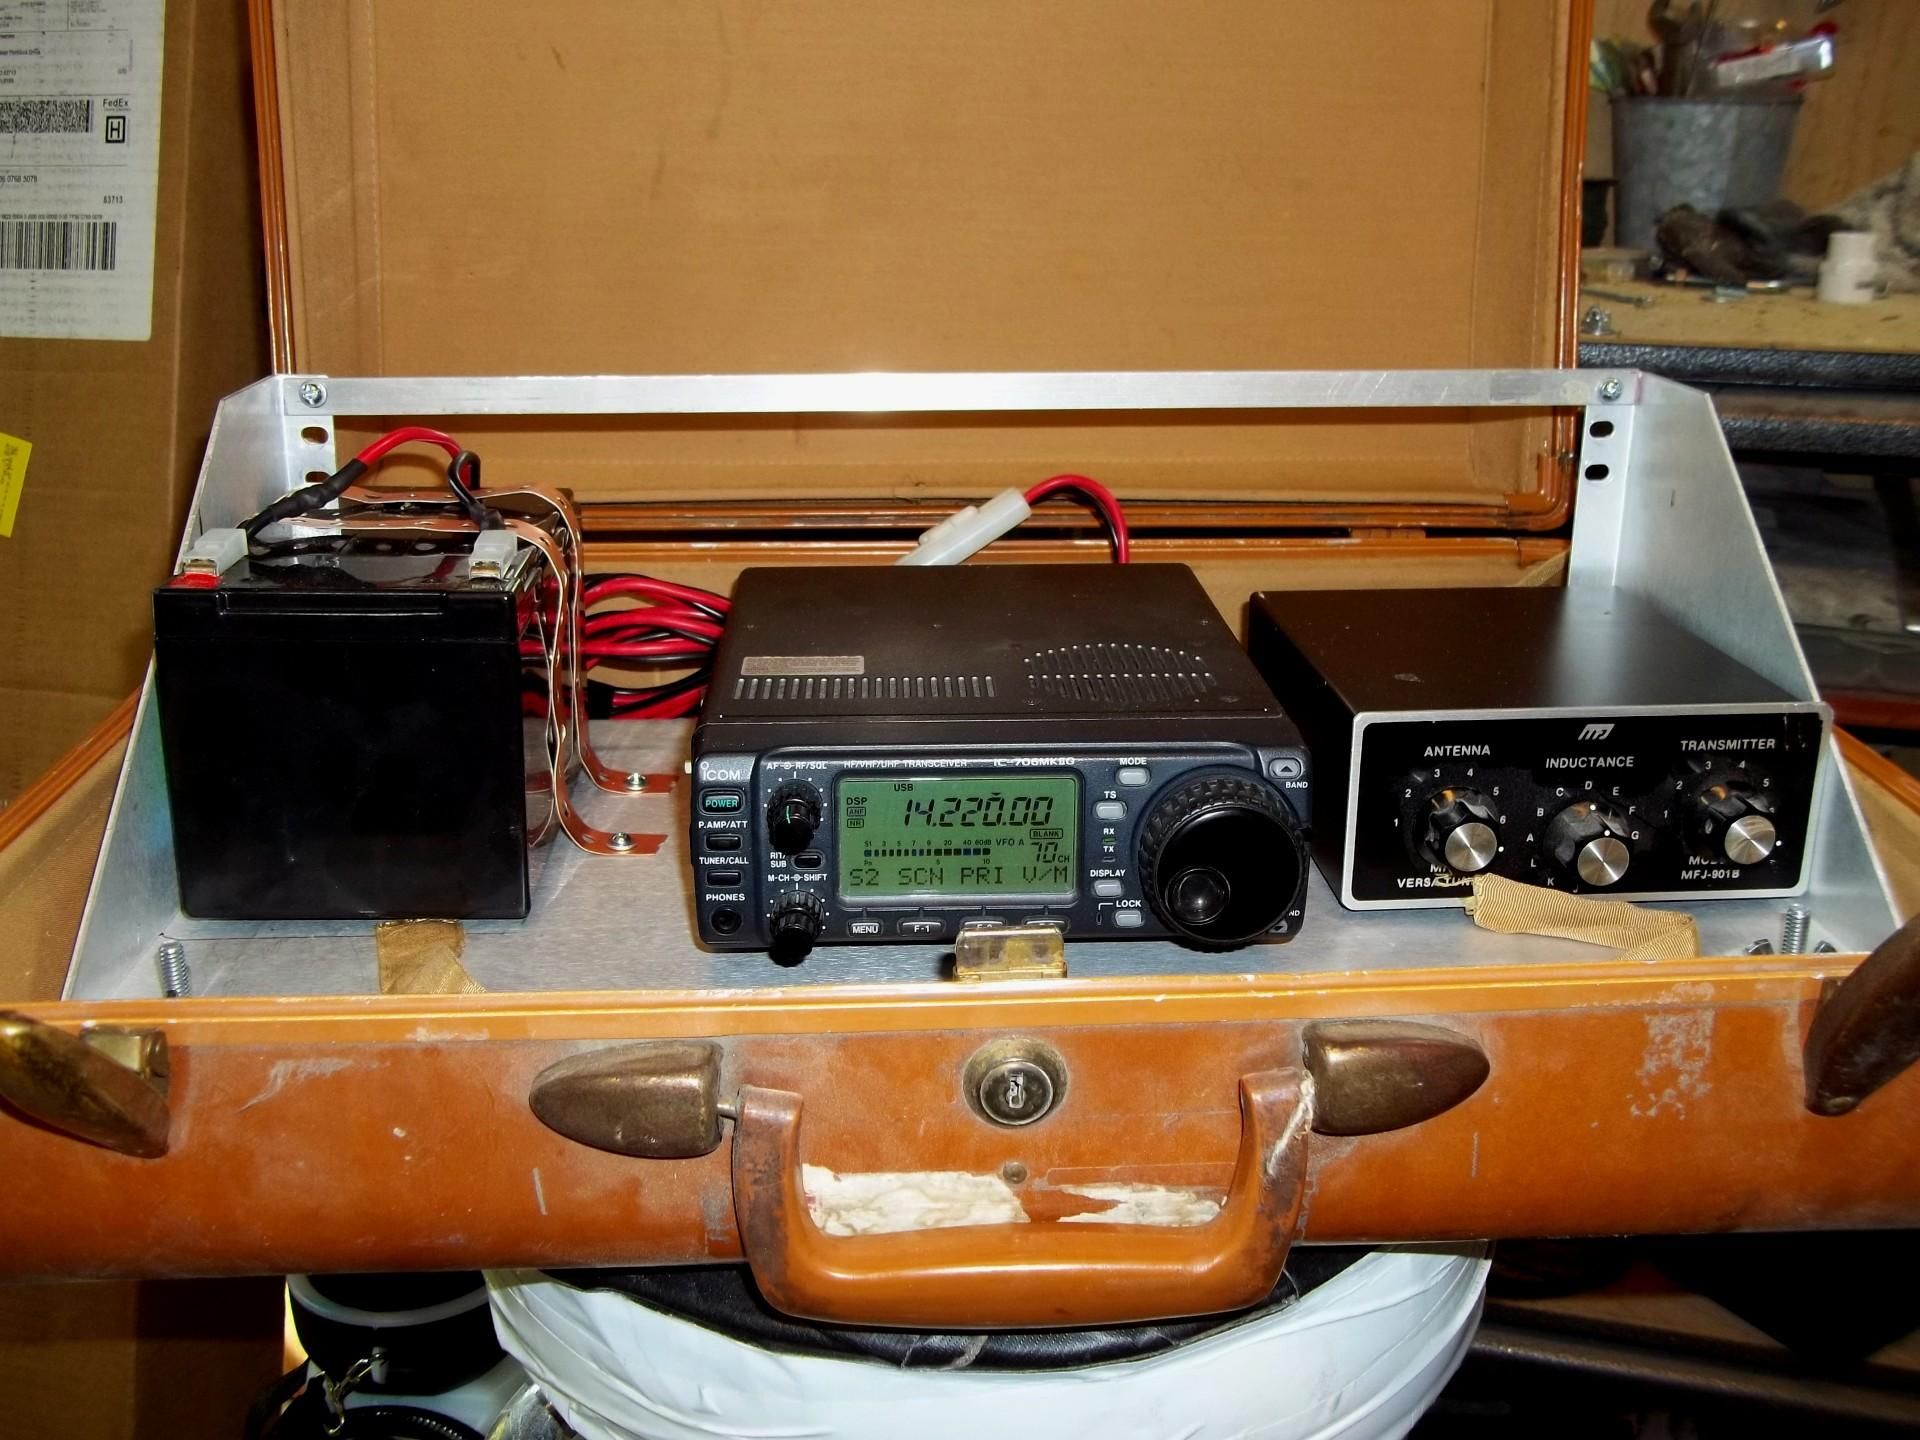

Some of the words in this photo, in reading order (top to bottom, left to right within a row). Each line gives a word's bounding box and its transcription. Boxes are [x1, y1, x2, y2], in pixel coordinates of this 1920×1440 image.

[103, 98, 128, 107] FedEx
[110, 120, 120, 138] H
[1680, 738, 1776, 751] TRANSMITTER
[1424, 744, 1490, 757] ANTENNA
[904, 760, 968, 768] TRANSCEIVER
[1120, 757, 1147, 766] MODE
[1546, 756, 1634, 768] INDUCTANCE
[894, 784, 914, 792] USB
[1584, 780, 1592, 790] D
[1664, 810, 1668, 818] 1
[1676, 780, 1683, 790] 2
[1704, 760, 1712, 770] 3
[1738, 760, 1746, 769] 4
[1763, 778, 1770, 788] 5
[1556, 787, 1564, 796] C
[1613, 786, 1620, 796] E
[846, 797, 868, 806] DSP
[1394, 818, 1398, 827] 1
[1405, 788, 1412, 798] 2
[1434, 768, 1441, 778] 3
[1467, 768, 1474, 777] 4
[1493, 787, 1500, 796] 5
[1500, 815, 1506, 824] 6
[705, 800, 738, 808] POWER
[904, 797, 1054, 826] 14.220.00
[1536, 808, 1544, 817] B
[1629, 806, 1636, 816] F
[698, 820, 748, 828] P.AMP/ATT
[1526, 833, 1534, 842] A
[1631, 830, 1640, 840] G
[996, 839, 1015, 848] VFO
[699, 856, 749, 864] TUNER/CALL
[1530, 858, 1536, 868] L
[768, 874, 790, 882] M-CH
[804, 874, 828, 882] SHIFT
[850, 868, 880, 886] S2
[898, 867, 944, 886] SCN
[960, 866, 1004, 884] PRI
[1022, 866, 1068, 884] V/M
[1090, 869, 1126, 878] DISPLAY
[1681, 869, 1740, 880] MFJ-901B
[1547, 878, 1554, 886] K
[706, 894, 746, 902] PHONES
[1116, 900, 1142, 908] LOCK
[852, 925, 879, 934] MENU
[914, 924, 930, 932] F-1
